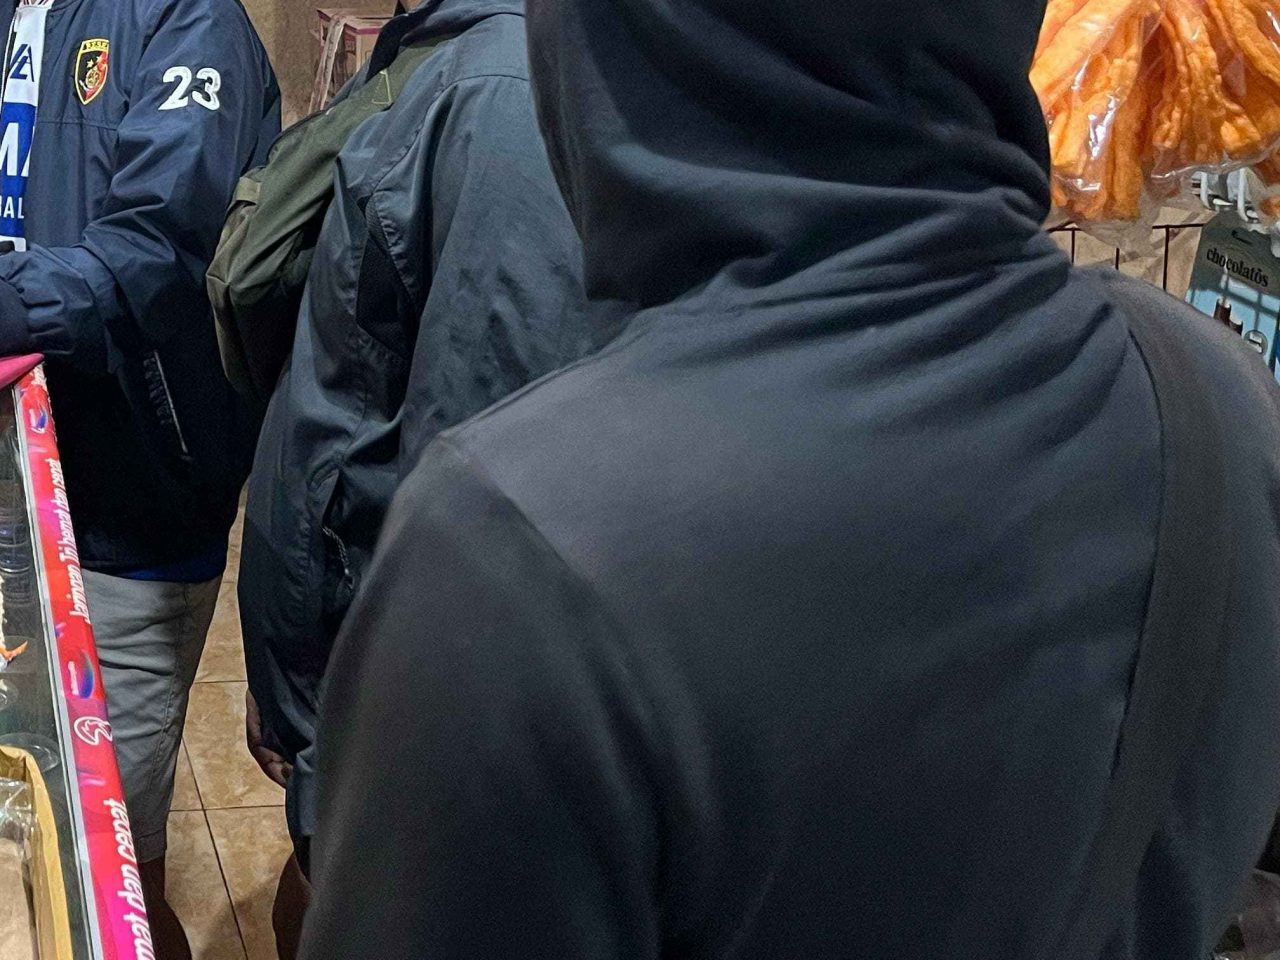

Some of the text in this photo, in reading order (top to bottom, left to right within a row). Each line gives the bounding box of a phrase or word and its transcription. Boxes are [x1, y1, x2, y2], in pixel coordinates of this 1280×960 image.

[158, 65, 221, 111] 23
[104, 797, 136, 863] cepat
[117, 864, 146, 909] dan
